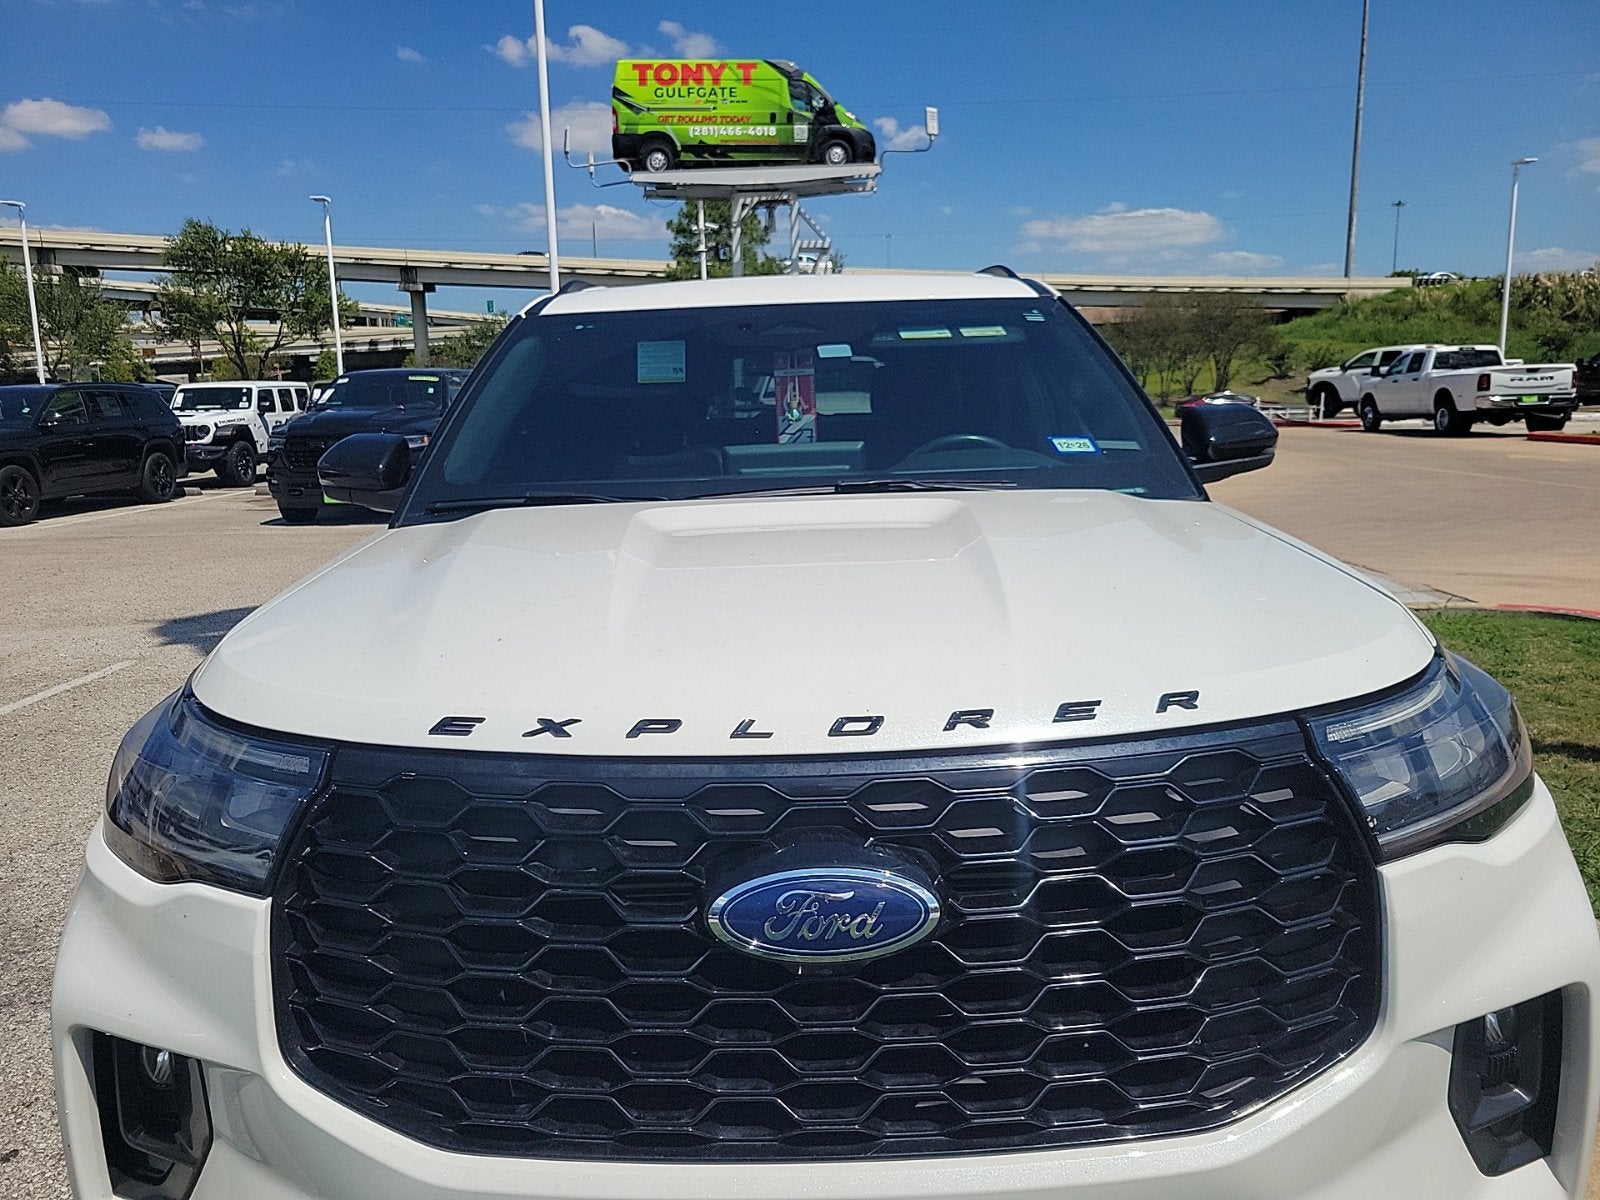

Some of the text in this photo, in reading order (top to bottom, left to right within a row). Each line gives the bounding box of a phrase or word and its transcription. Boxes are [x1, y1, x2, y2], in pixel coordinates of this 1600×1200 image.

[632, 63, 758, 86] TONY T
[654, 87, 738, 98] GULFGATE
[677, 115, 718, 124] ROLLING
[719, 115, 752, 124] TODAY
[689, 125, 777, 137] (281)466-4018
[427, 689, 1201, 739] EXPLORER
[763, 889, 885, 941] Ford
